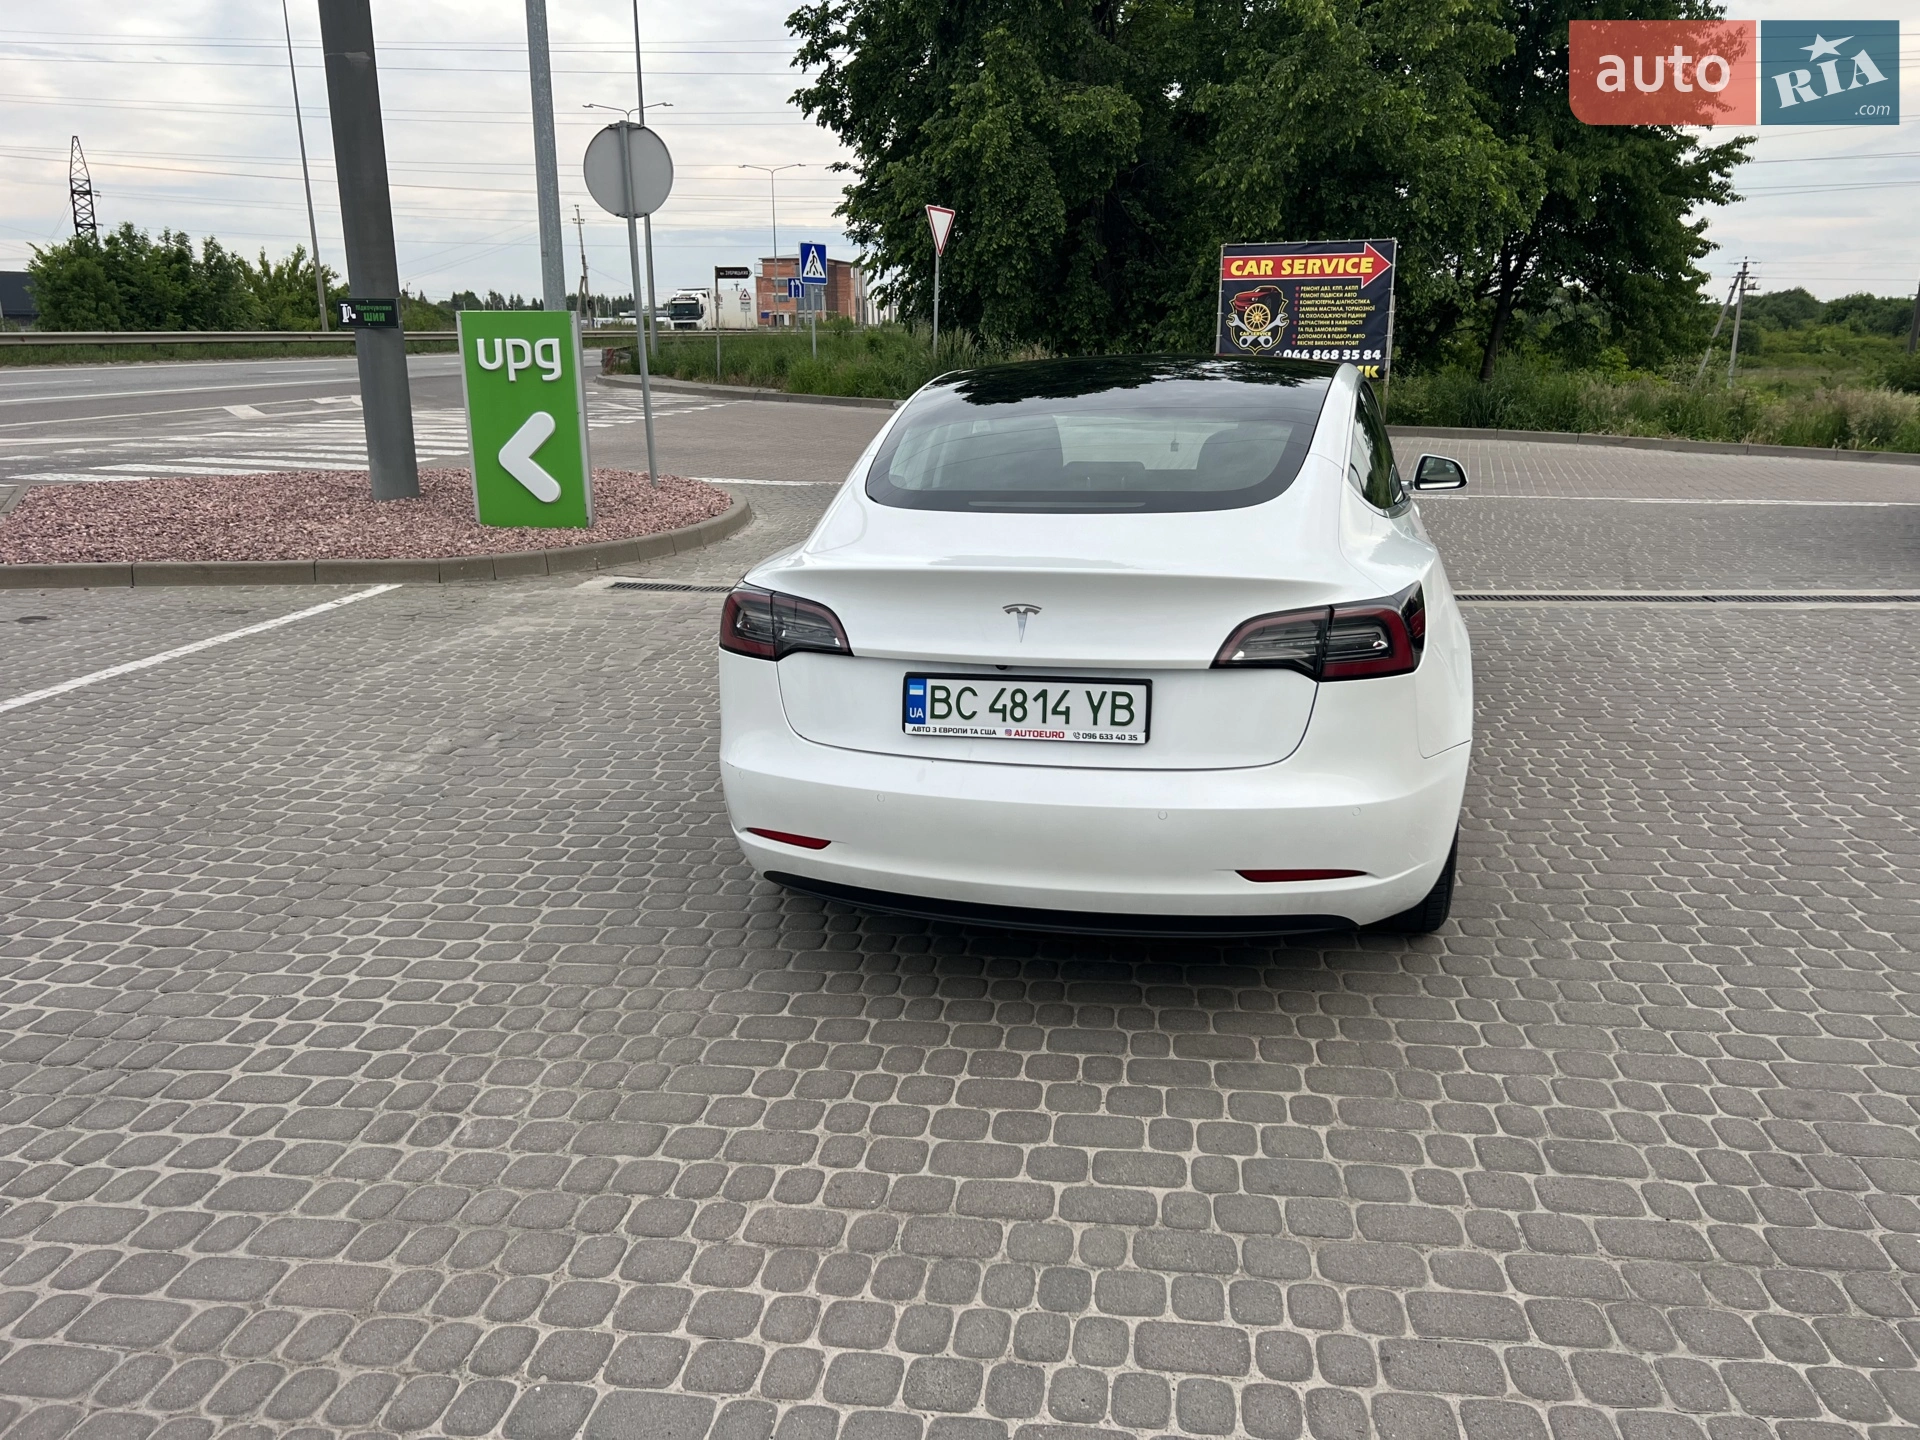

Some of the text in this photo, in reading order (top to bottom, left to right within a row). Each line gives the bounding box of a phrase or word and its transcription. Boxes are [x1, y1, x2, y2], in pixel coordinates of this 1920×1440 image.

[1230, 257, 1374, 276] CAR SERVICE
[363, 312, 386, 322] ШИН
[1283, 349, 1382, 360] 066 868 35 84
[476, 338, 562, 382] upg
[930, 685, 1135, 727] BC 4814 YB
[910, 708, 924, 718] UA
[938, 727, 968, 735] ЄВРОПИ
[1013, 729, 1065, 739] AUTOEURO
[1081, 732, 1097, 740] 096
